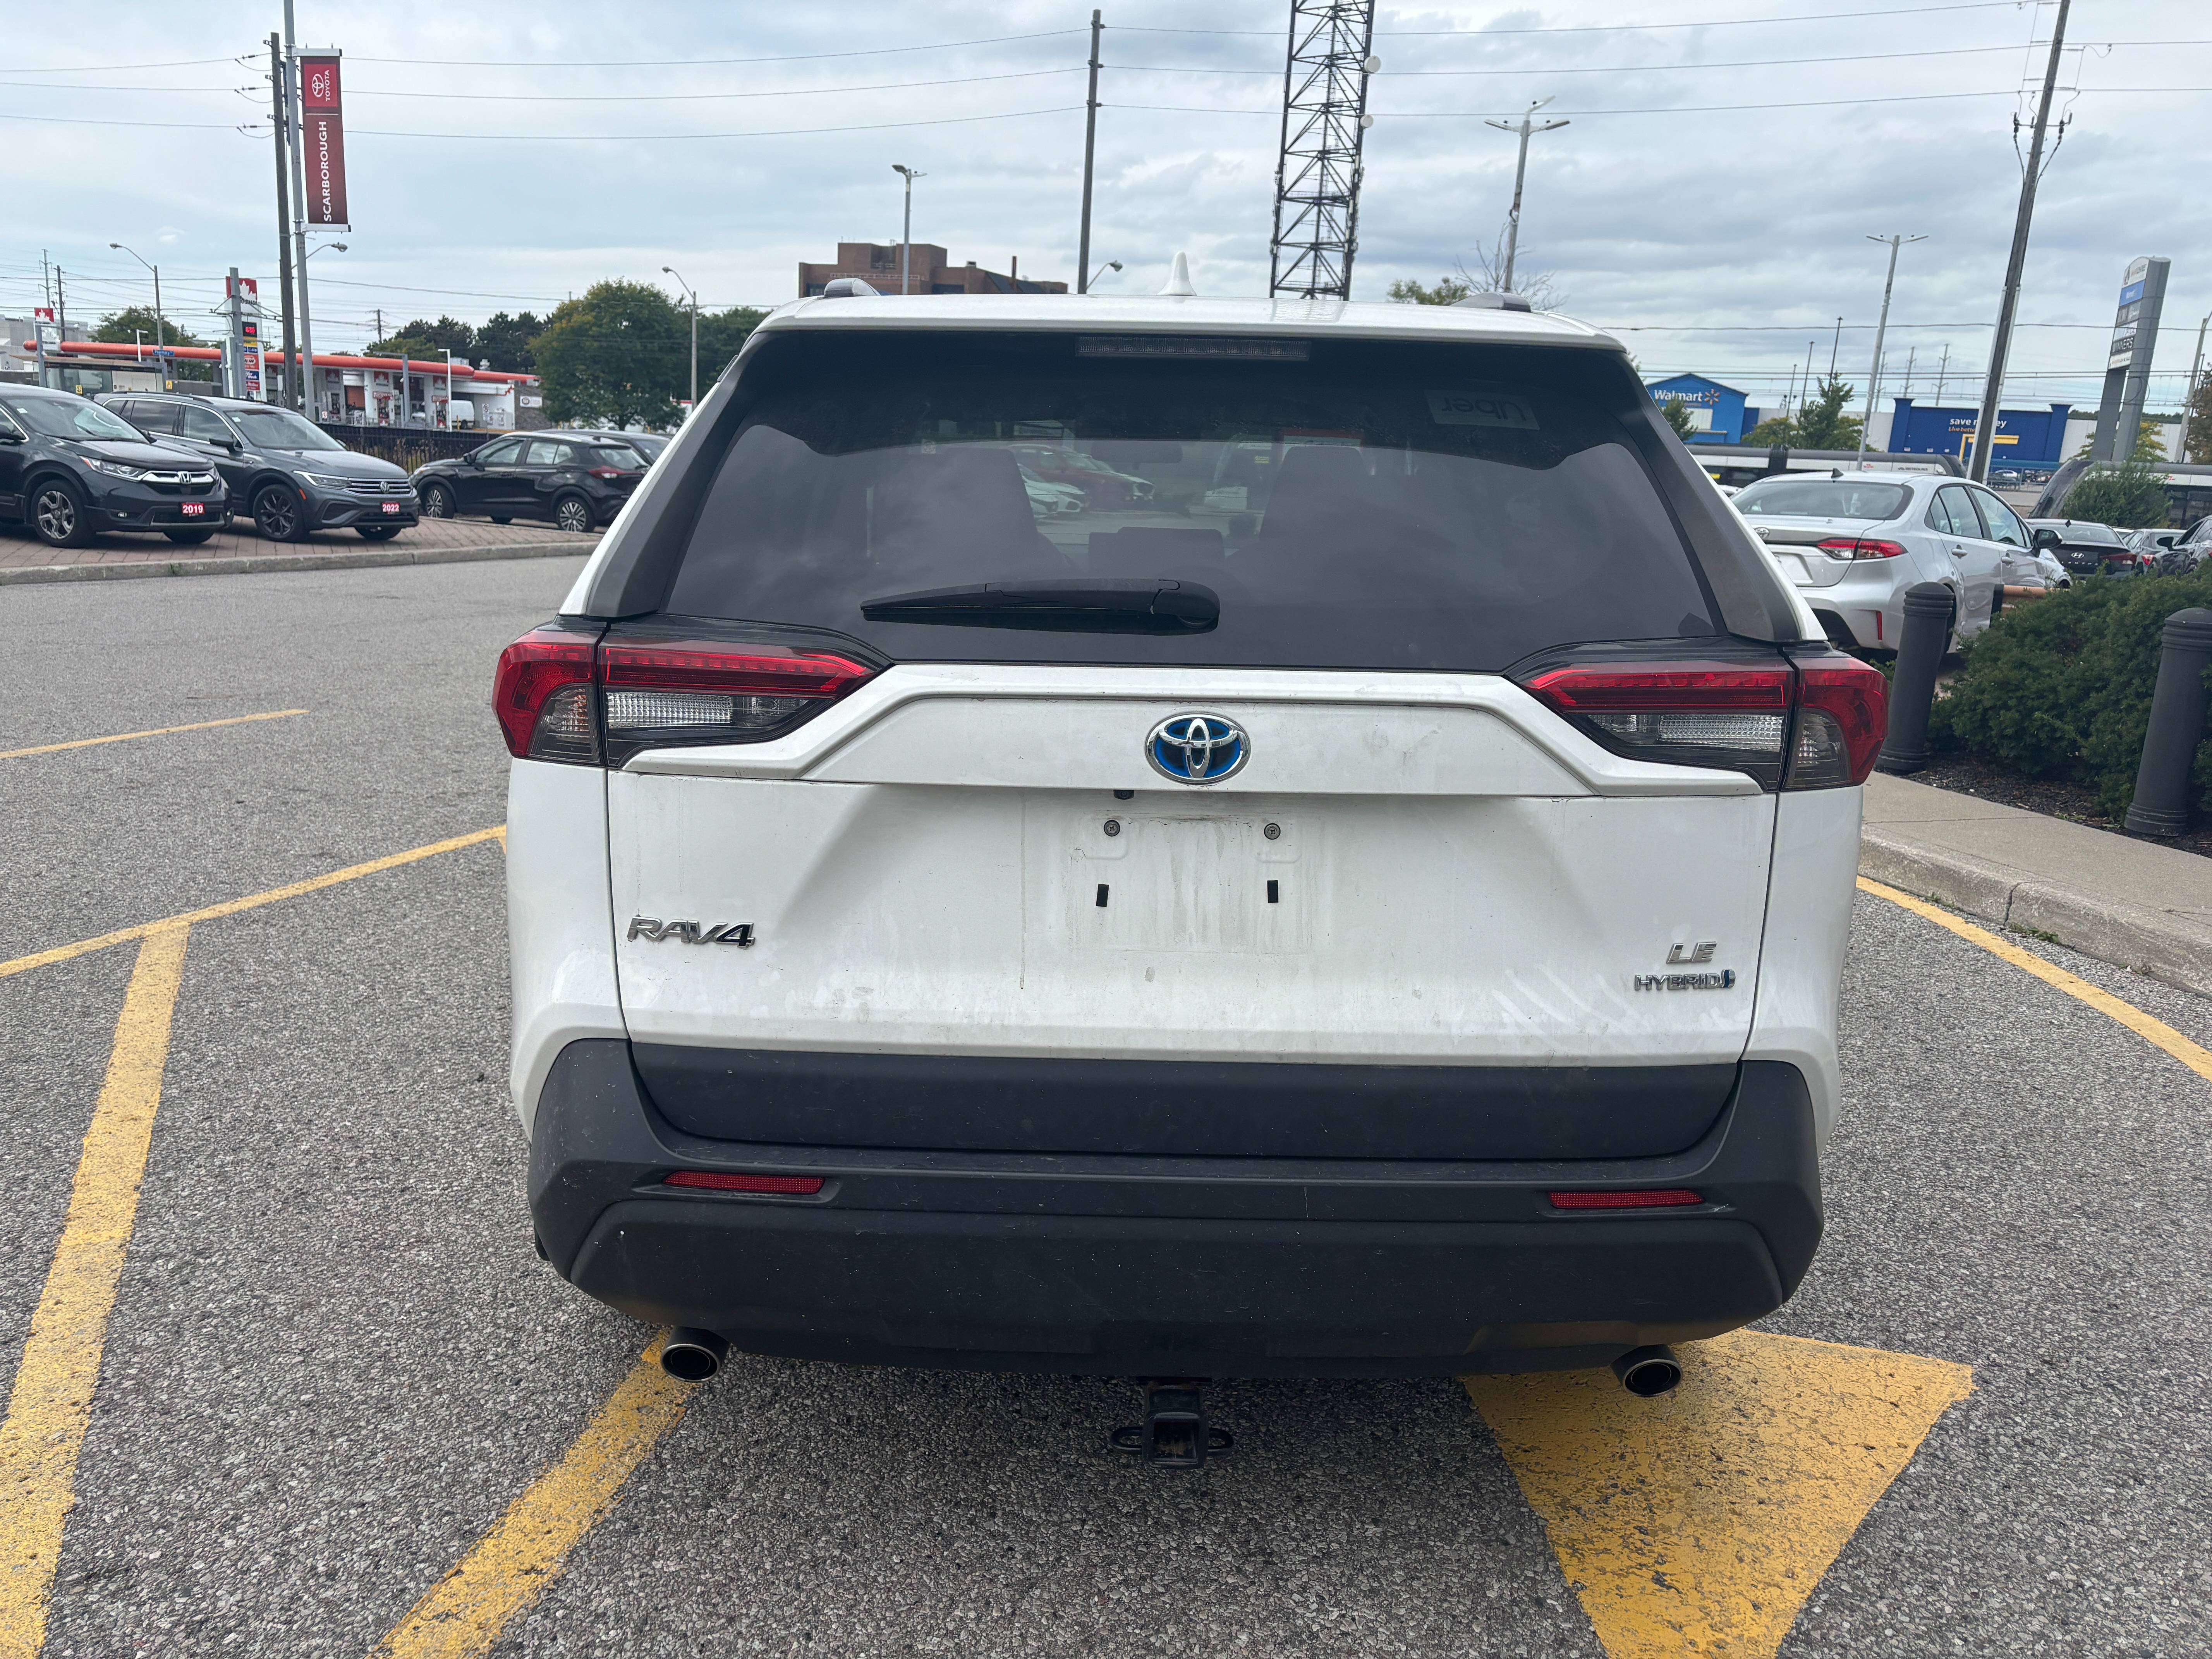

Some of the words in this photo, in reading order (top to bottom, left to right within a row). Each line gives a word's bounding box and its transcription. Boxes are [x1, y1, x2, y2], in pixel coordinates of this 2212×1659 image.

[318, 121, 332, 222] SCARBOROUGH
[1654, 390, 1703, 402] Walmart
[182, 505, 203, 514] 2019
[382, 504, 399, 512] 2022
[627, 916, 755, 949] RAV4
[1666, 941, 1717, 963] LE
[1634, 973, 1720, 990] HYBRID
